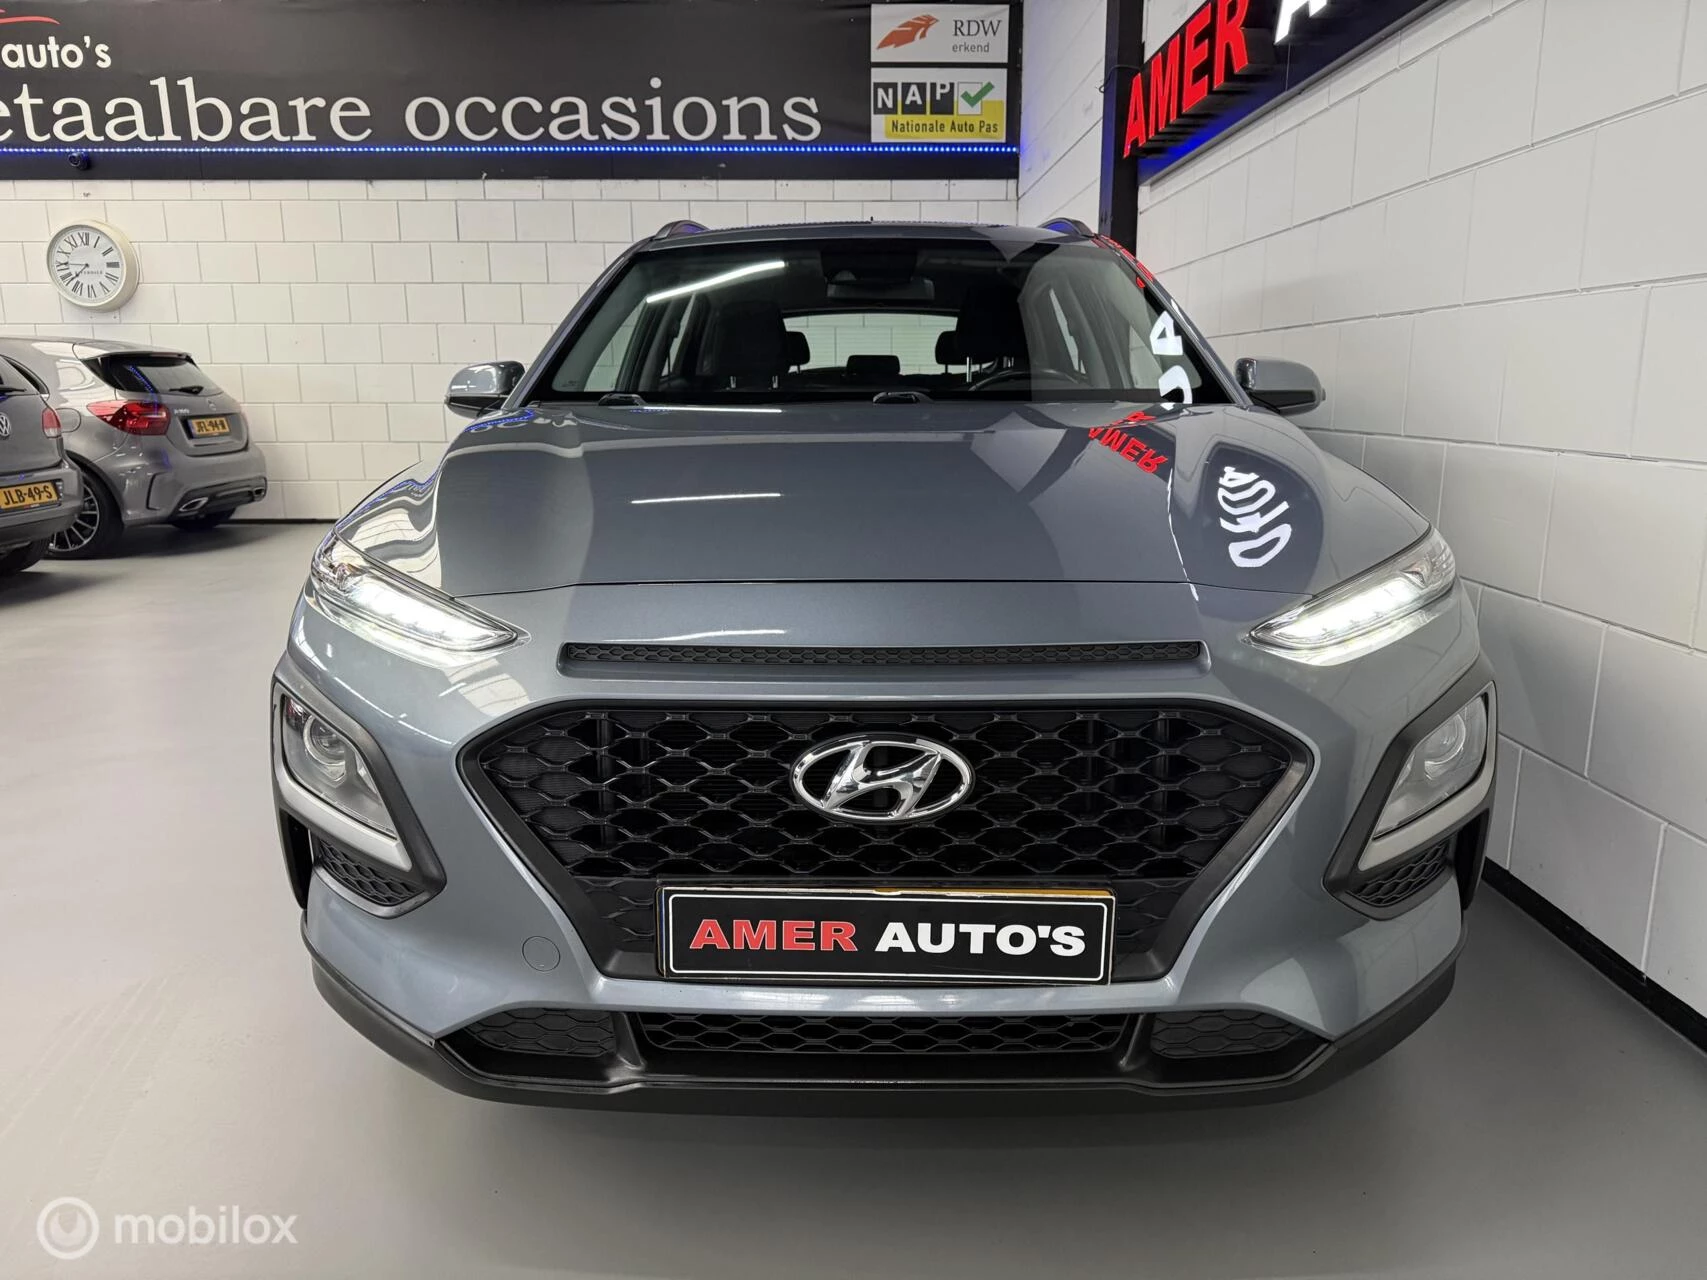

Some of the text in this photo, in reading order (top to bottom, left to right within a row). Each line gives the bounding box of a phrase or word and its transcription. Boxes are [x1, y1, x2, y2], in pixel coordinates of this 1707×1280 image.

[952, 19, 1002, 37] RDW
[1, 35, 112, 69] auto's
[952, 42, 990, 53] erkend
[1123, 0, 1249, 159] AMER
[403, 76, 822, 143] occasions
[891, 119, 999, 133] Nationale Auto Pas
[3, 484, 53, 506] JLB-49-S
[689, 919, 1086, 957] AMER AUTO'S
